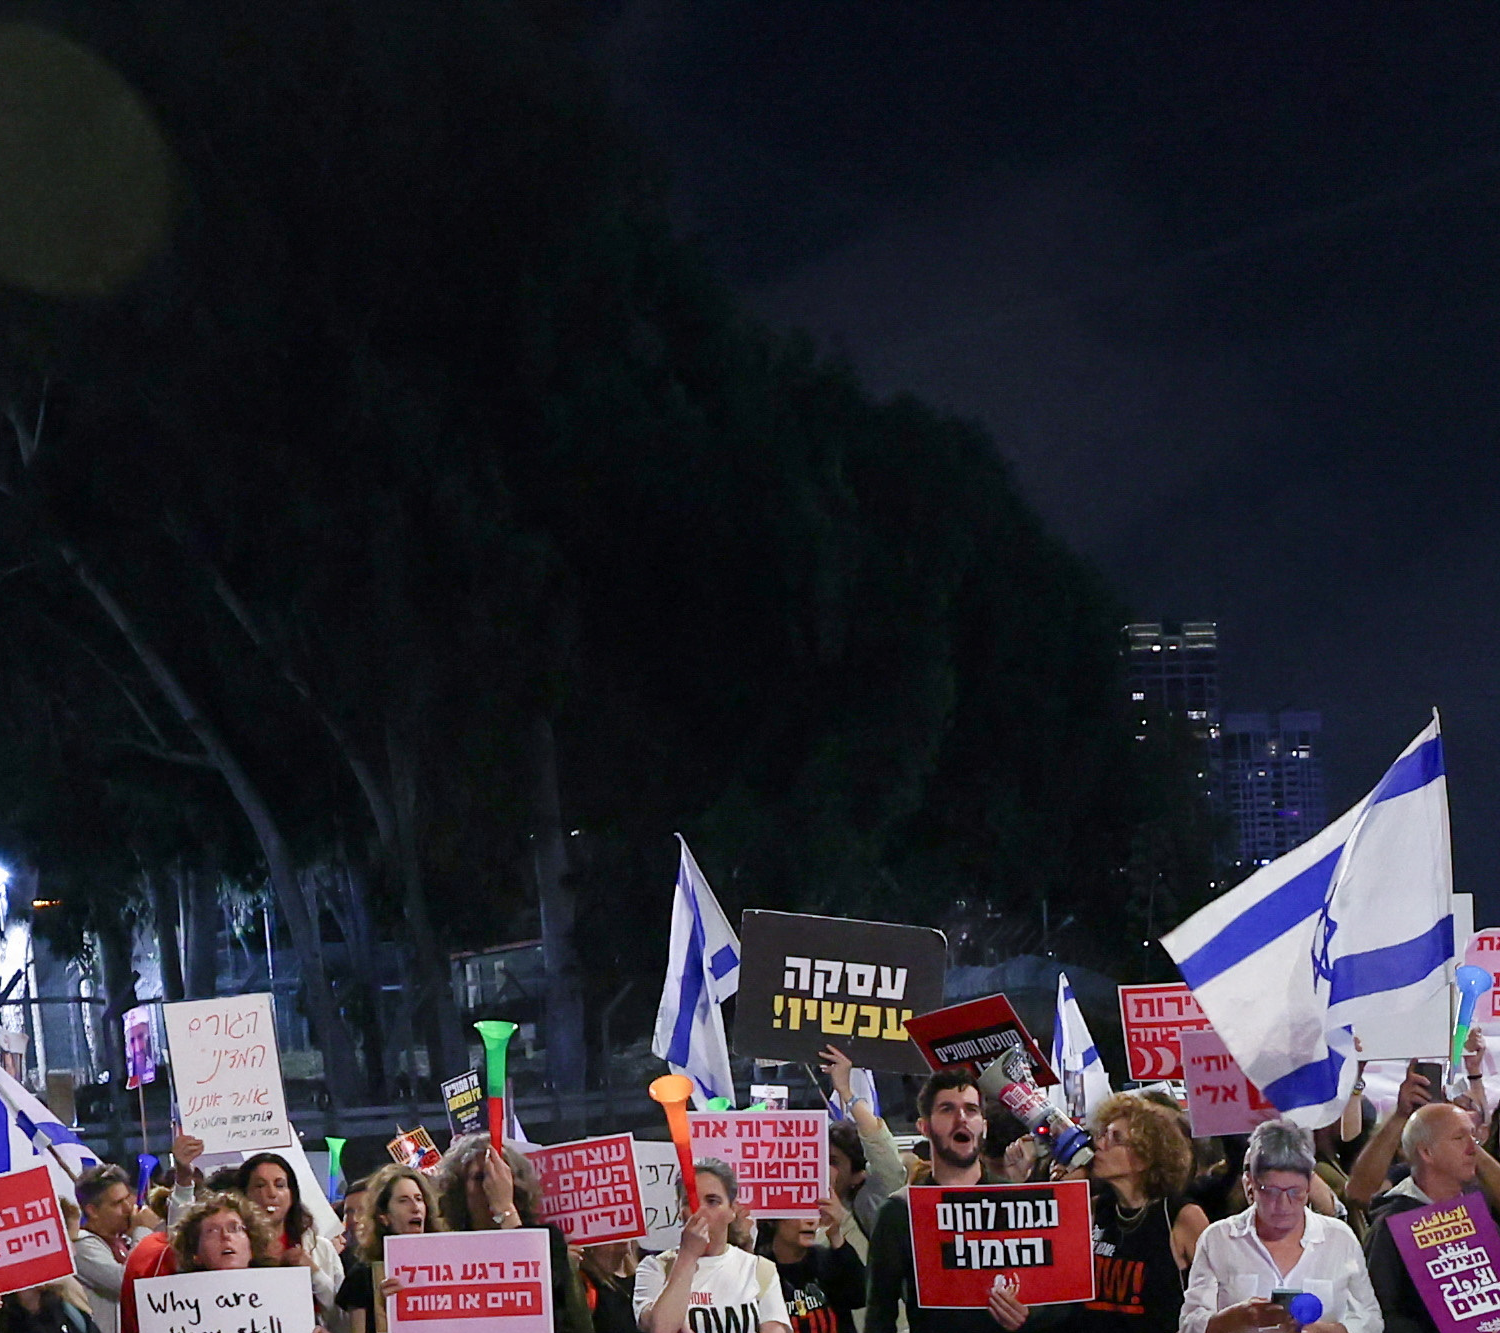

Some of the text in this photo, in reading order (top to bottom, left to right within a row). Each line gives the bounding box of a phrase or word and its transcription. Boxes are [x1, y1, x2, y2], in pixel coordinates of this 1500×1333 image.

[784, 955, 908, 1000] עסקה
[772, 994, 913, 1041] עכשיו!
[692, 1120, 818, 1138] עוצרות את
[551, 1143, 627, 1172] עוצרות
[741, 1140, 819, 1159] העולם
[559, 1164, 630, 1193] העולם
[731, 1161, 818, 1179] החטופו
[761, 1185, 818, 1207] עדיין
[23, 1197, 52, 1222] זה
[582, 1208, 635, 1235] עדיין
[1001, 1200, 1059, 1229] נגמר
[8, 1229, 51, 1254] חיים
[954, 1234, 1046, 1270] הזמן!
[394, 1260, 541, 1284] זה רגע גורלי
[1431, 1251, 1487, 1275] מצילים
[147, 1291, 263, 1326] Why are
[406, 1290, 533, 1312] חיים או מוות
